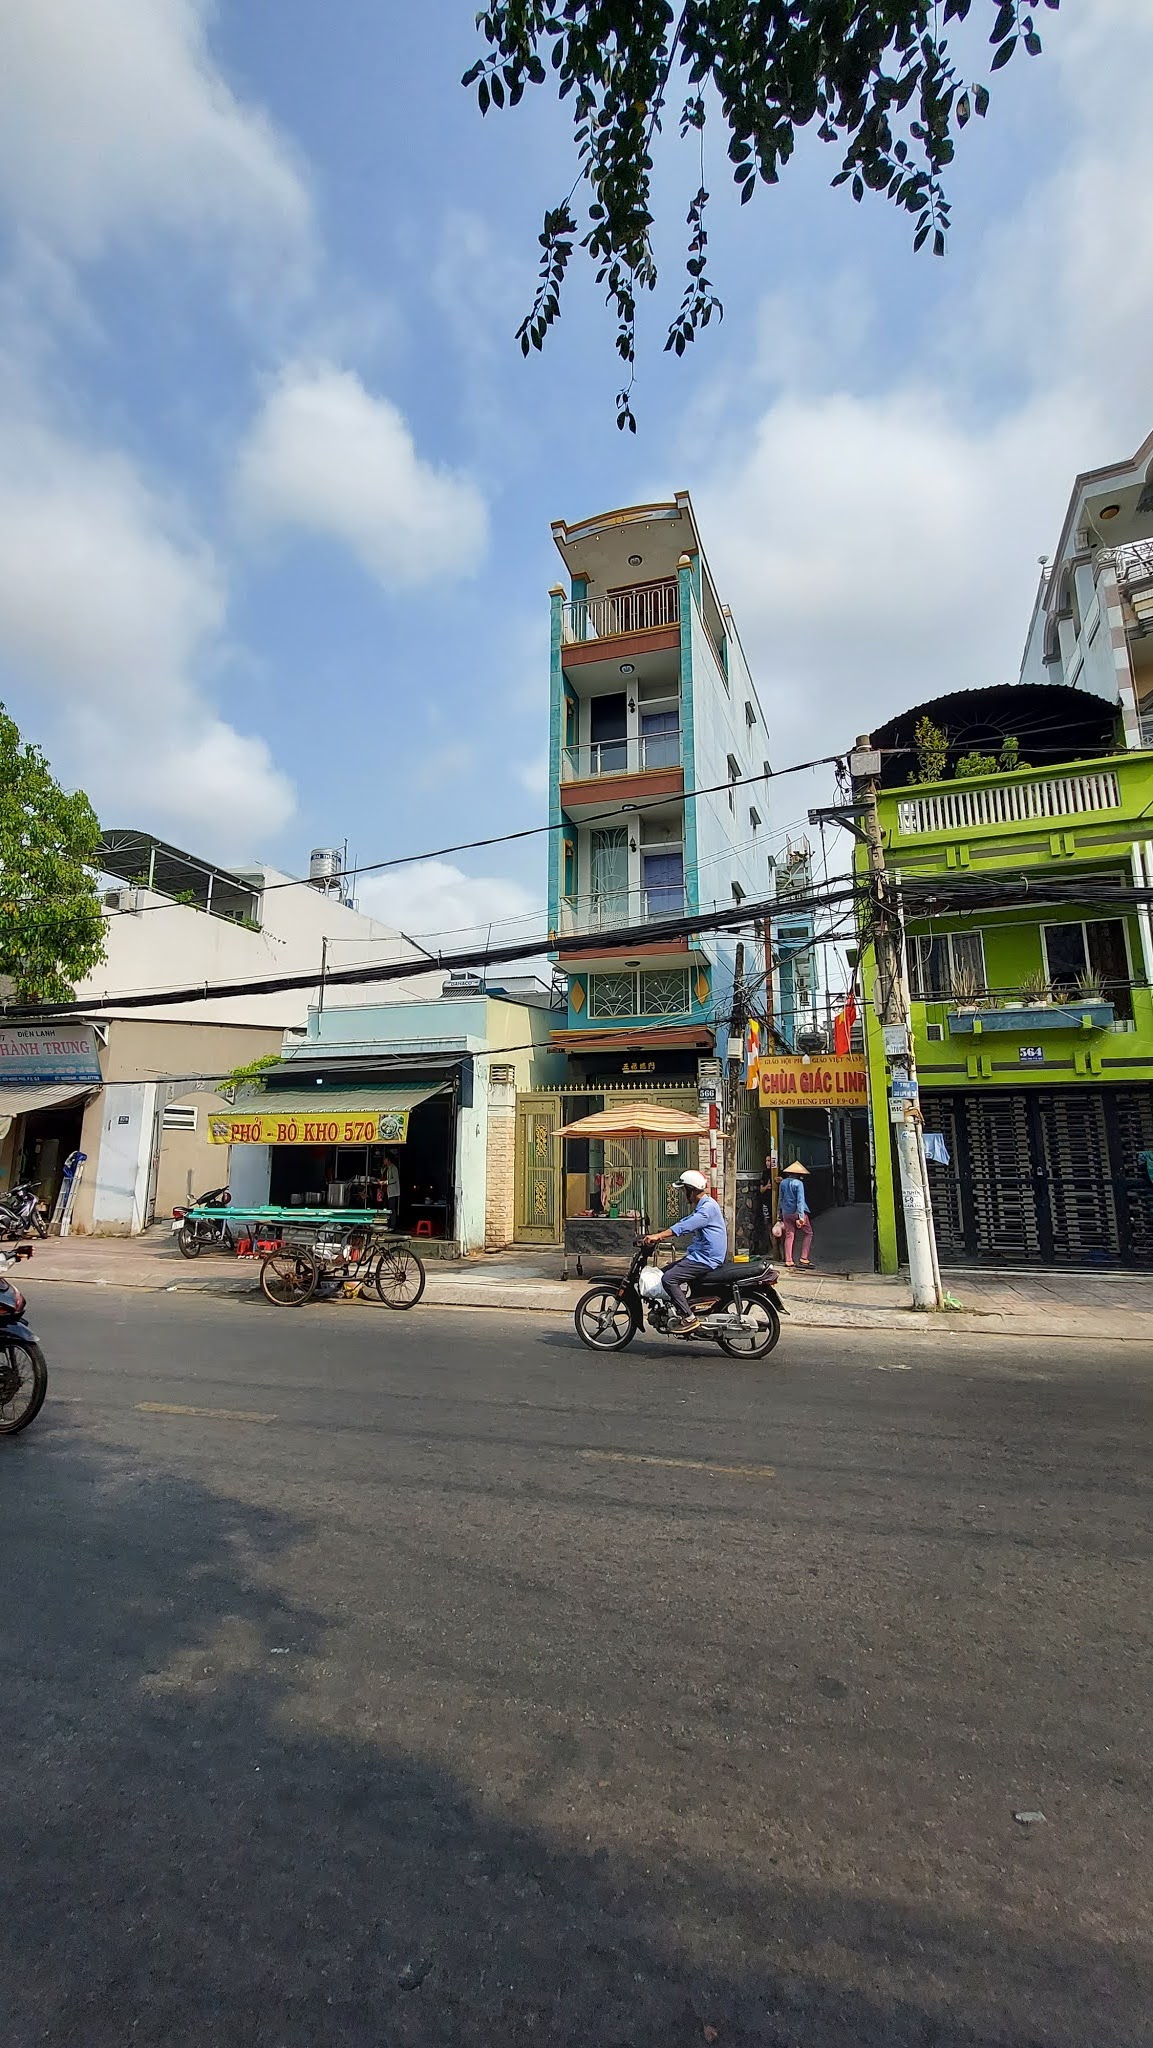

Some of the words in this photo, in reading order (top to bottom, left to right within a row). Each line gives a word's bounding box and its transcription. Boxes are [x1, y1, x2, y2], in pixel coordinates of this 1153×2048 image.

[0, 1040, 41, 1056] HÀNH
[43, 1041, 90, 1055] TRUNG
[1020, 1047, 1042, 1057] 564
[828, 1055, 843, 1064] VIỆT
[762, 1068, 797, 1094] CHÙA
[800, 1066, 832, 1093] GIÁC
[836, 1072, 867, 1093] LINH
[699, 1089, 715, 1097] 566
[818, 1097, 834, 1105] PHÚ
[230, 1117, 263, 1142] PHỞ
[276, 1118, 298, 1141] BÒ
[302, 1122, 338, 1141] KHO
[343, 1122, 375, 1141] 570
